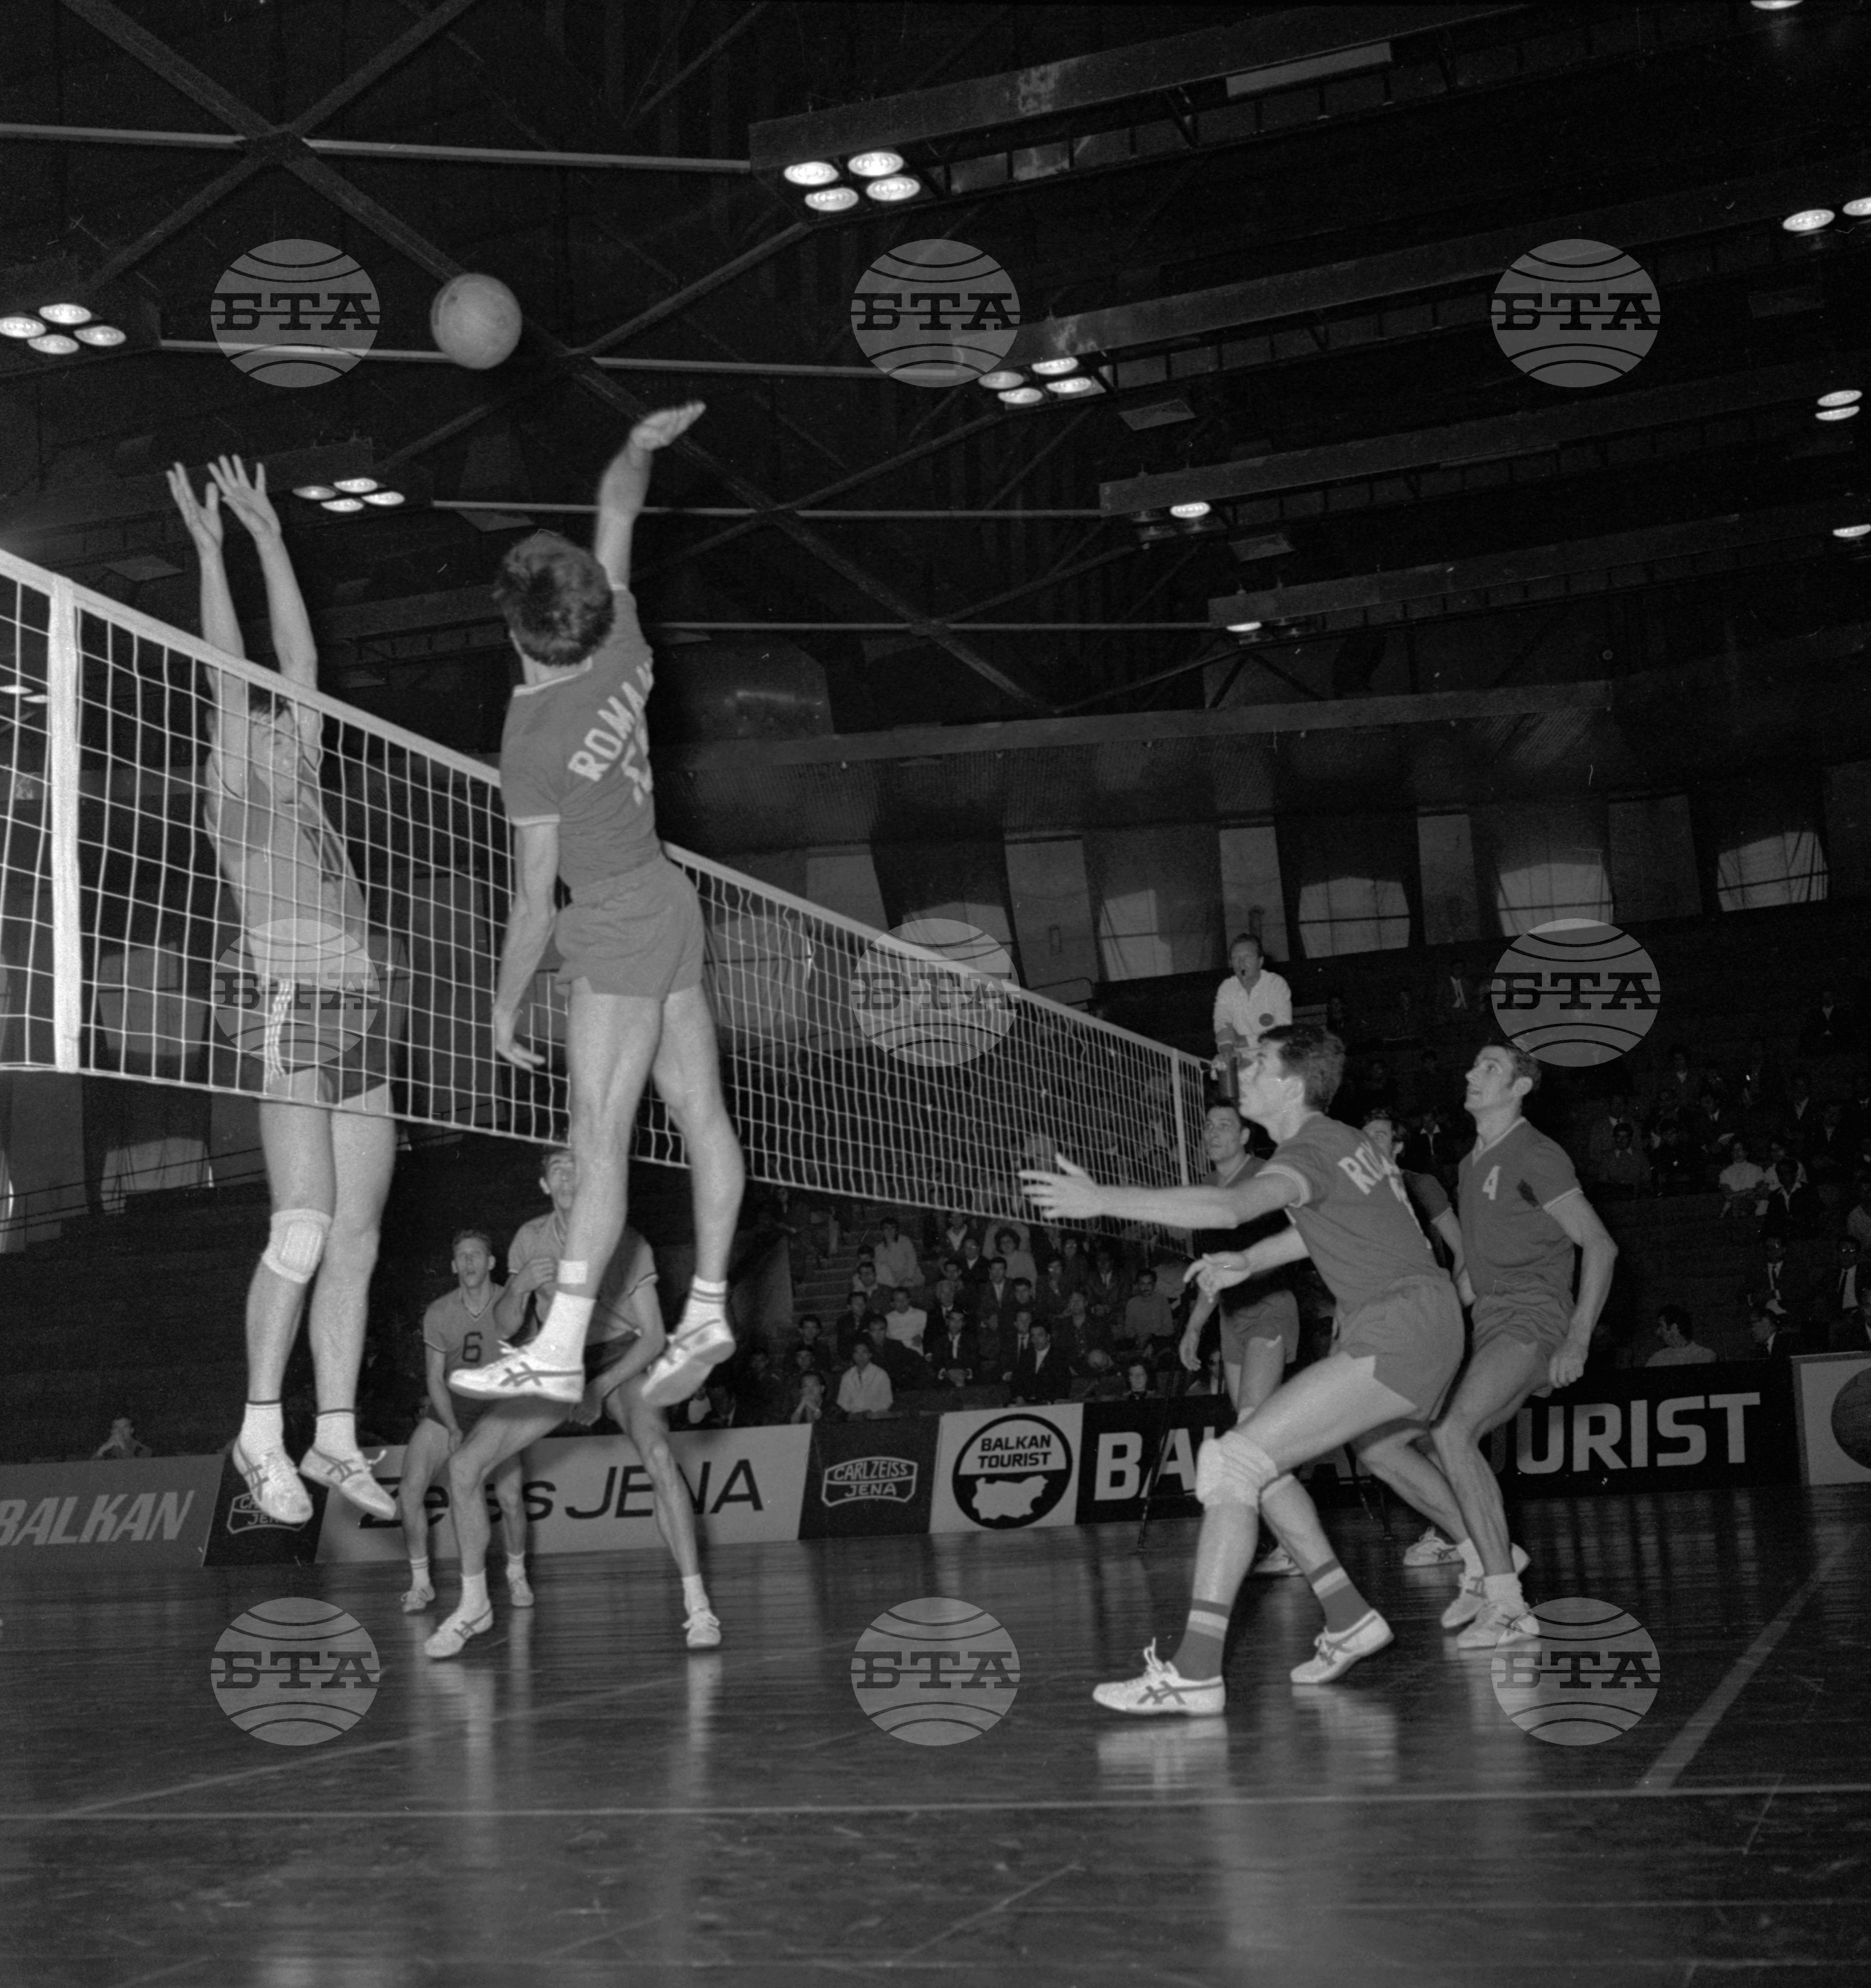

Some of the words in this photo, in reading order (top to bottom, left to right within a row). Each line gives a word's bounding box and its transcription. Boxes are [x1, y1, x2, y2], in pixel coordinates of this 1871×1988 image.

[1482, 1165, 1501, 1200] 4
[462, 1331, 483, 1363] 6
[981, 1434, 1051, 1452] BALKAN
[978, 1451, 1052, 1469] TOURIST
[565, 1459, 764, 1520] JENA
[845, 1483, 897, 1497] JENA
[0, 1490, 195, 1547] BALKAN
